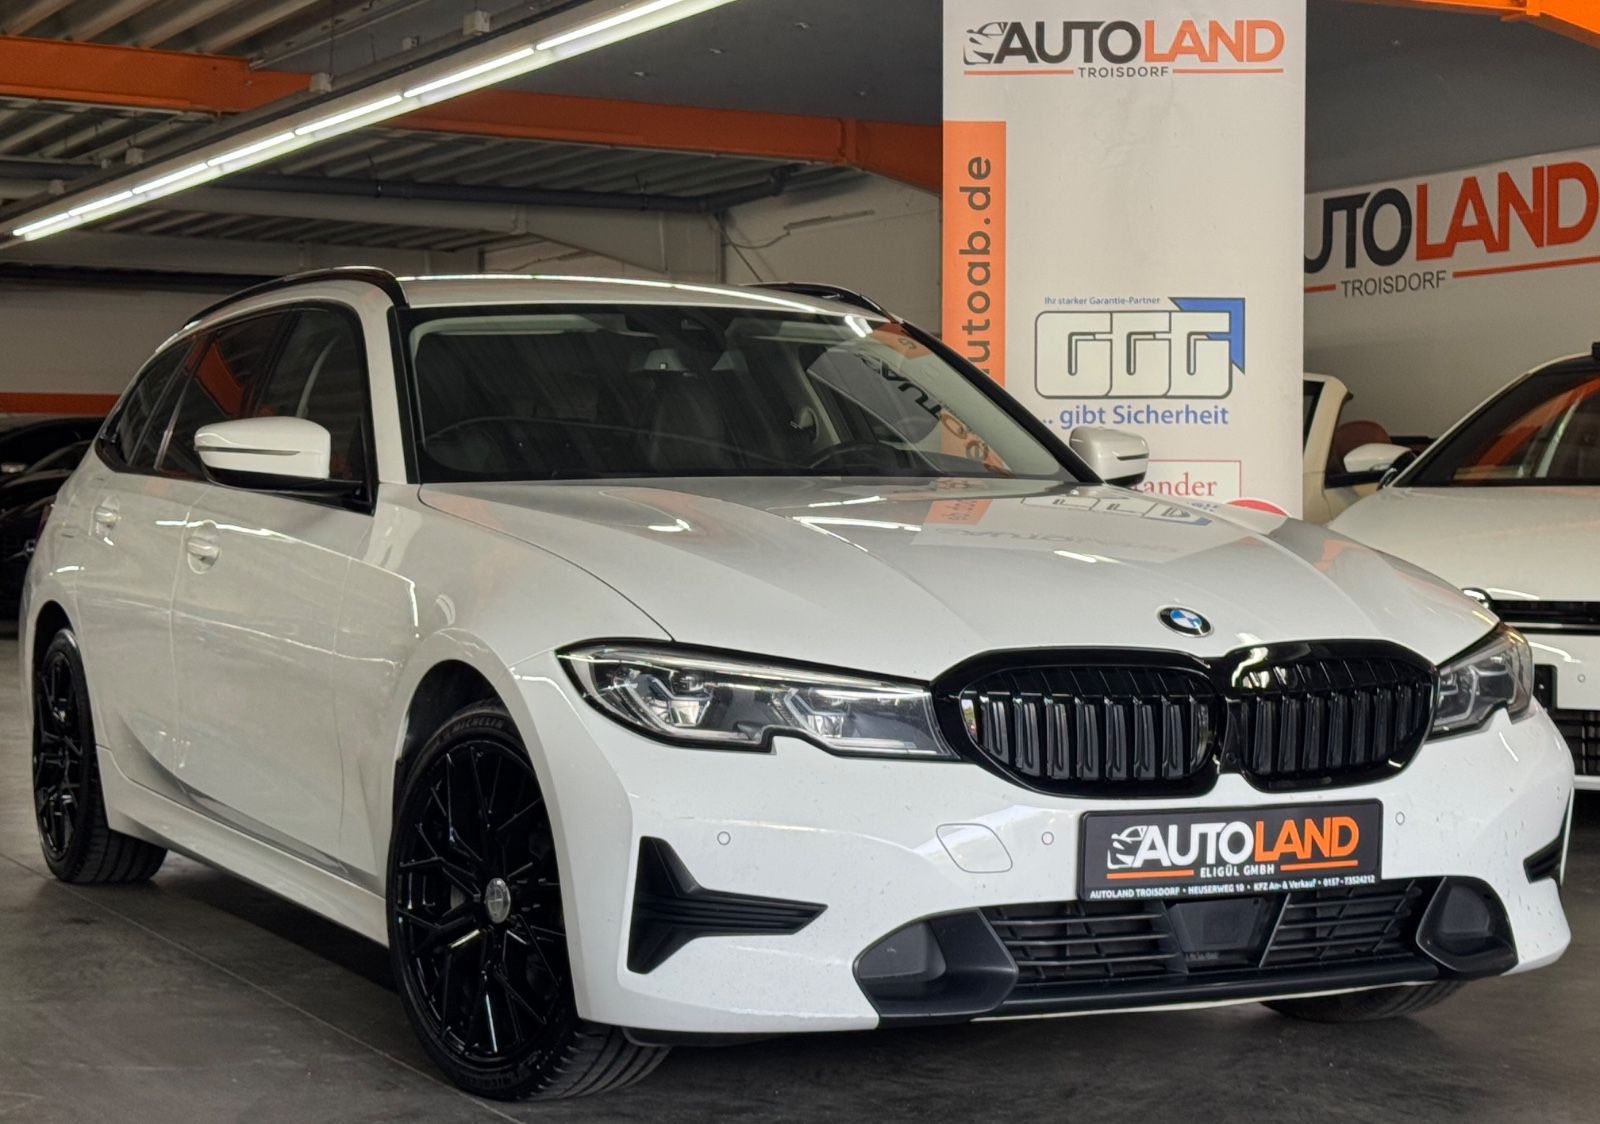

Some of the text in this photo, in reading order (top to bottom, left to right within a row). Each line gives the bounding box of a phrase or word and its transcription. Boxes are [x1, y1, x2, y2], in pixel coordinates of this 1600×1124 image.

[993, 19, 1286, 64] AUTOLAND
[1078, 65, 1169, 79] TROISDORF
[1304, 161, 1599, 274] UTOLAND
[958, 156, 991, 375] utoab.de
[1341, 270, 1447, 298] TROISDORF
[1044, 296, 1160, 305] Ihr starker Garantie-Partner
[1059, 405, 1107, 430] gibt
[1113, 404, 1229, 425] Sicherheit
[1131, 471, 1218, 497] ander
[1131, 816, 1360, 868] AUTOLAND
[1200, 863, 1275, 878] ELIGÜL GMBH
[1090, 888, 1135, 899] AUTOLAND
[1135, 886, 1181, 897] TROISDORF
[1188, 884, 1235, 896] HEUSERWEG
[1253, 881, 1269, 892] KFZ
[1289, 878, 1317, 889] Verkauf
